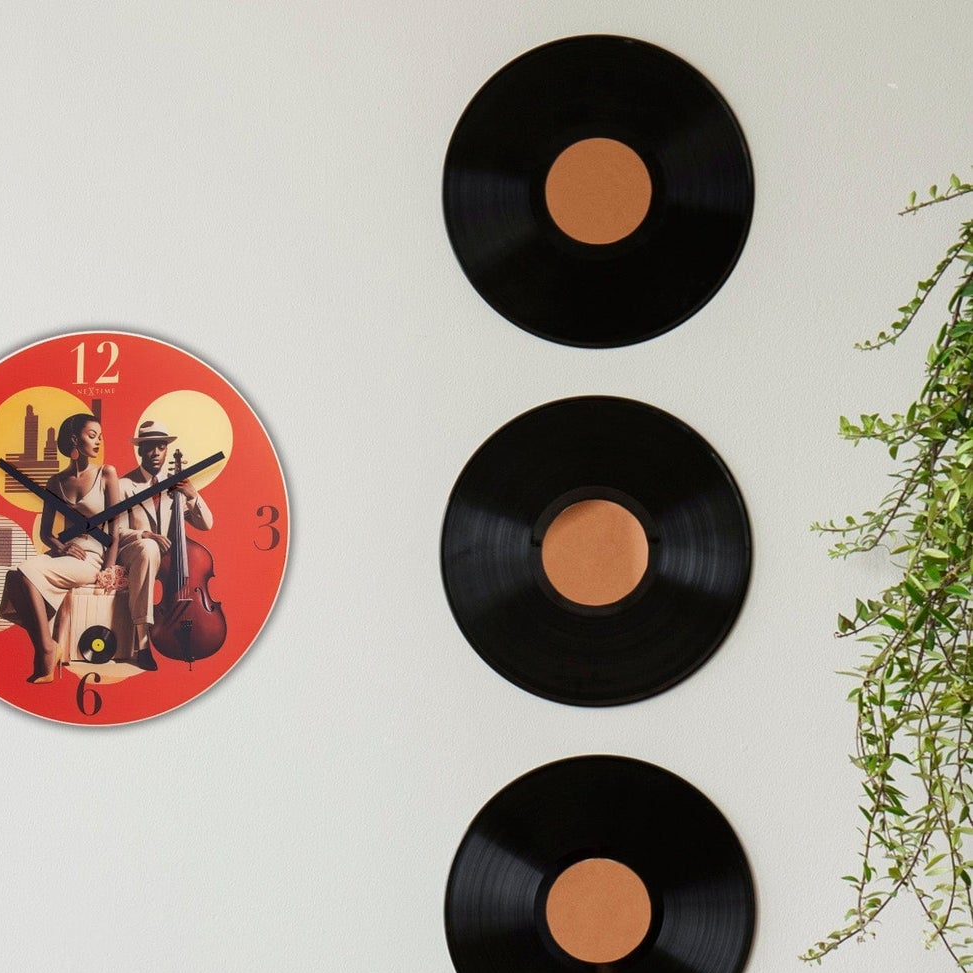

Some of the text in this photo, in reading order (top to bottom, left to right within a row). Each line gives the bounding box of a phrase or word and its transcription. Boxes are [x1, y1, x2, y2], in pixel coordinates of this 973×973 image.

[70, 341, 120, 385] 12
[253, 505, 280, 551] 3
[75, 672, 103, 717] 6
